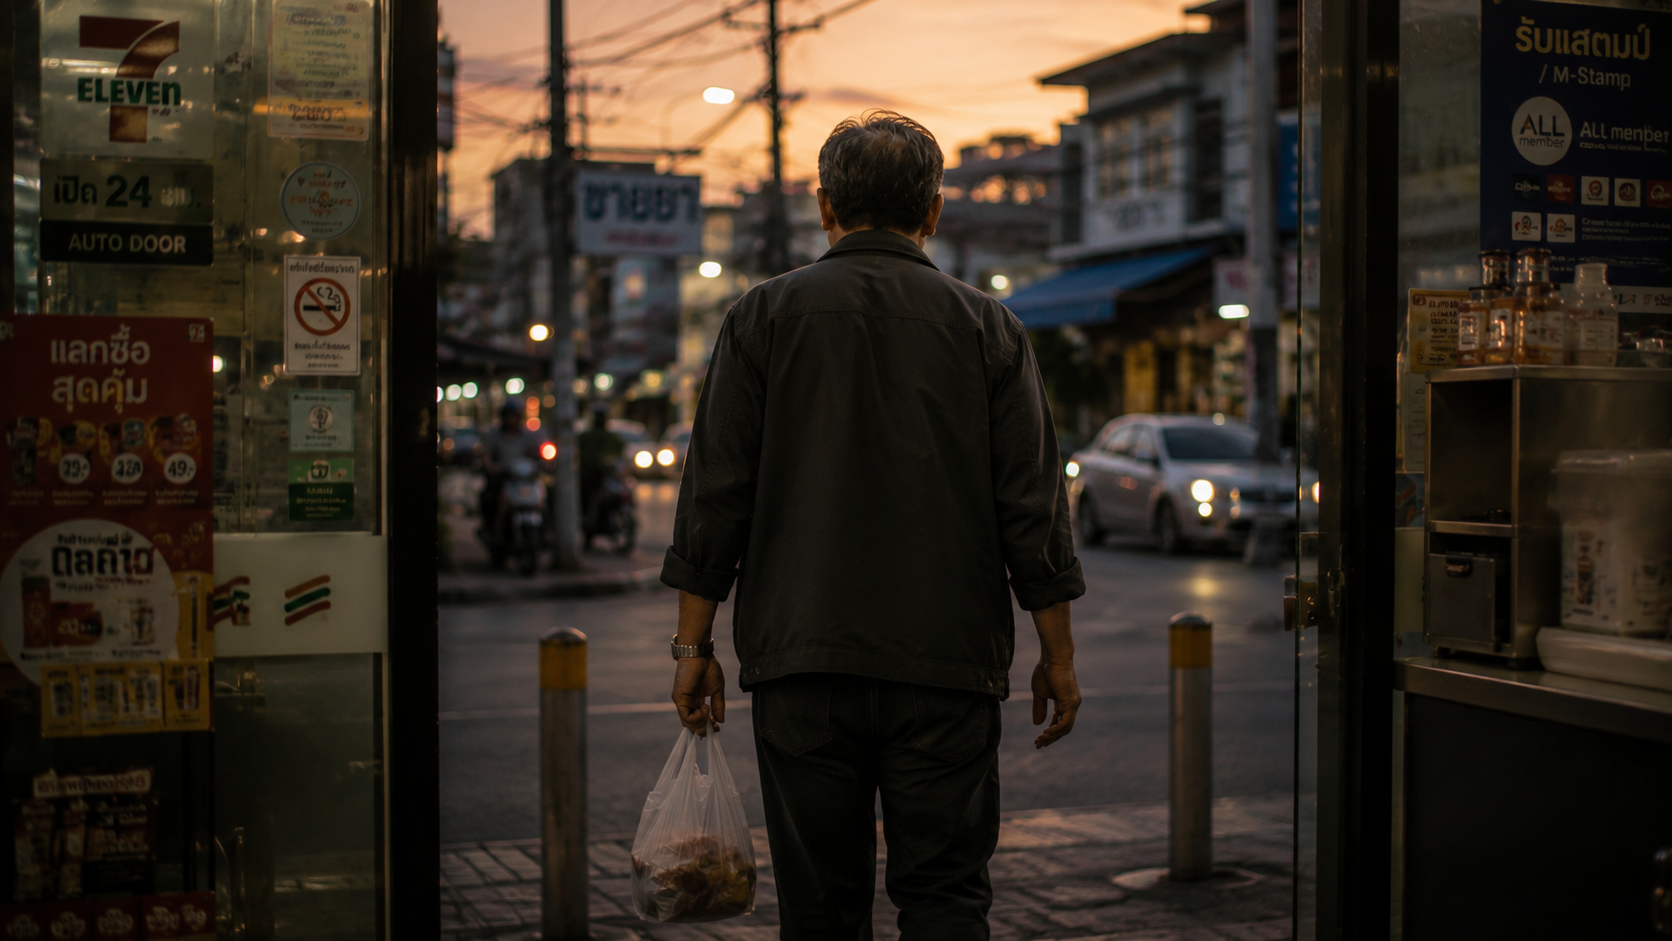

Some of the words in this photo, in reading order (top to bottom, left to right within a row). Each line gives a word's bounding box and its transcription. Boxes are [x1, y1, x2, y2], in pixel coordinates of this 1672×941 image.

[1553, 65, 1631, 91] M-Stamp
[1519, 113, 1565, 137] ALL
[1580, 121, 1608, 139] ALL
[1519, 136, 1565, 148] member
[106, 174, 152, 208] 24
[68, 232, 123, 252] AUTO
[129, 234, 187, 254] DOOR
